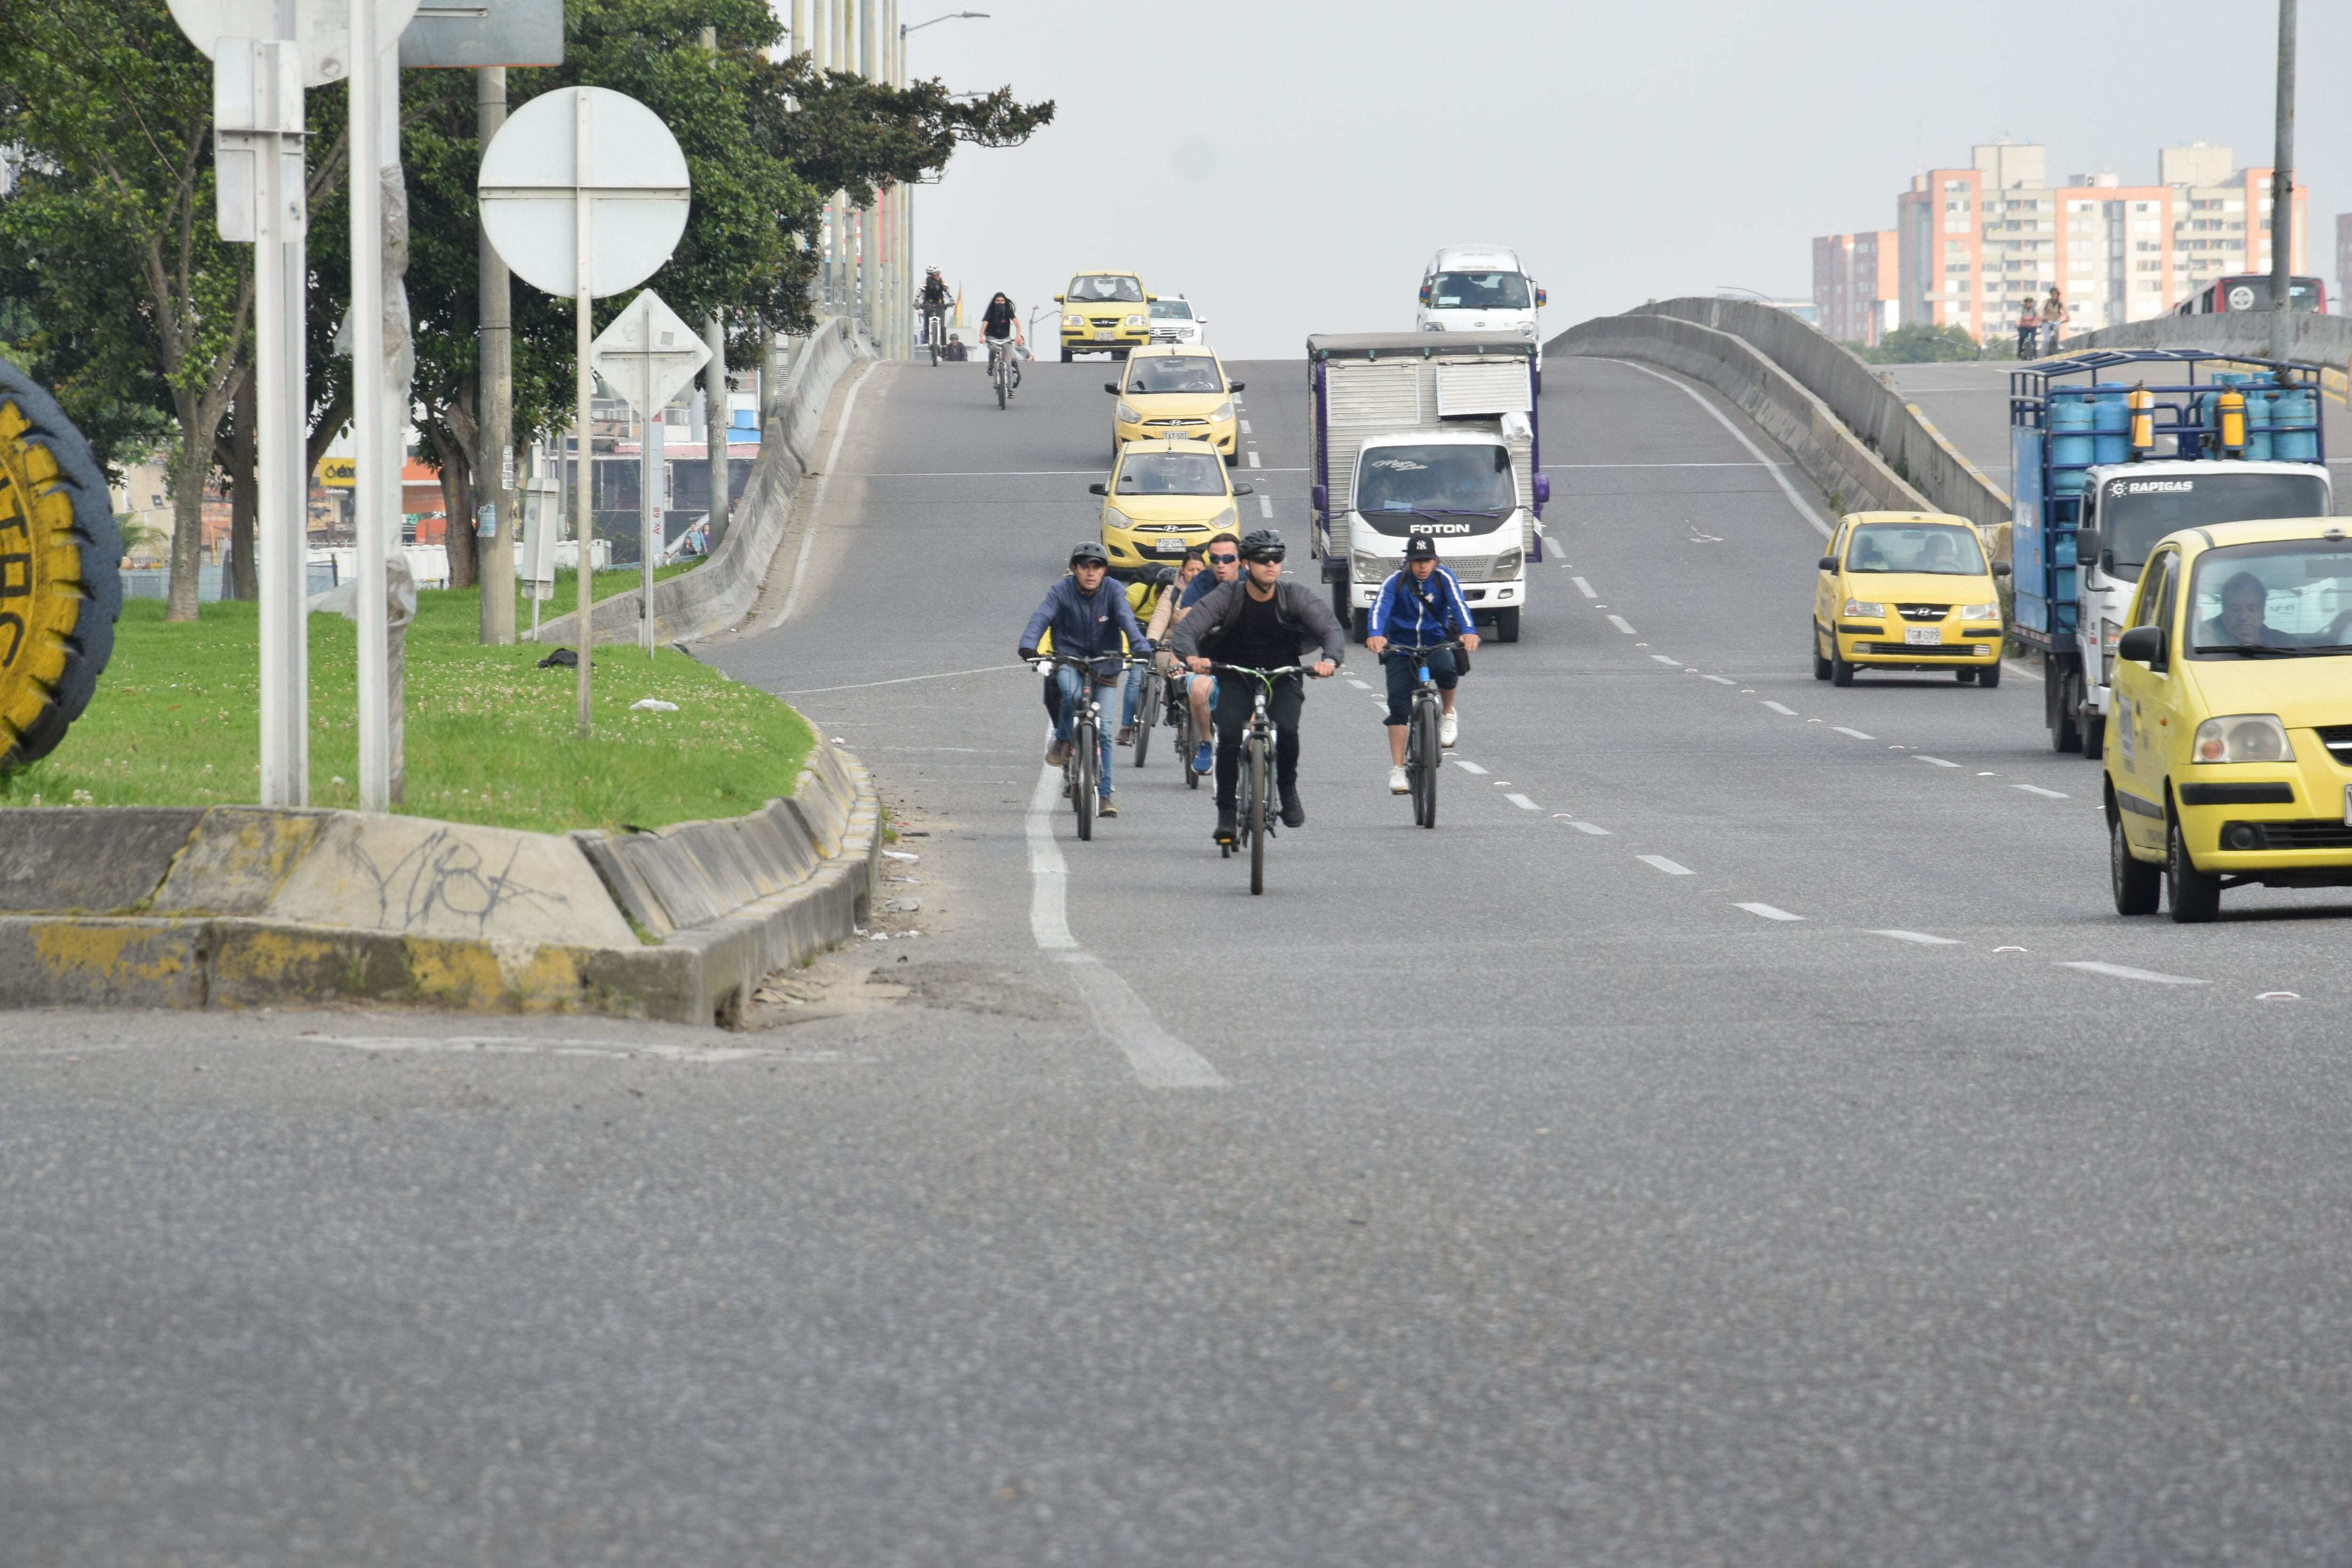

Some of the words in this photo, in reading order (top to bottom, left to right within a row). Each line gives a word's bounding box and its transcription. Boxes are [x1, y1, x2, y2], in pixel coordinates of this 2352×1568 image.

[2129, 481, 2193, 492] RAPIGAS
[652, 507, 660, 518] 68
[1410, 524, 1470, 533] FOTON
